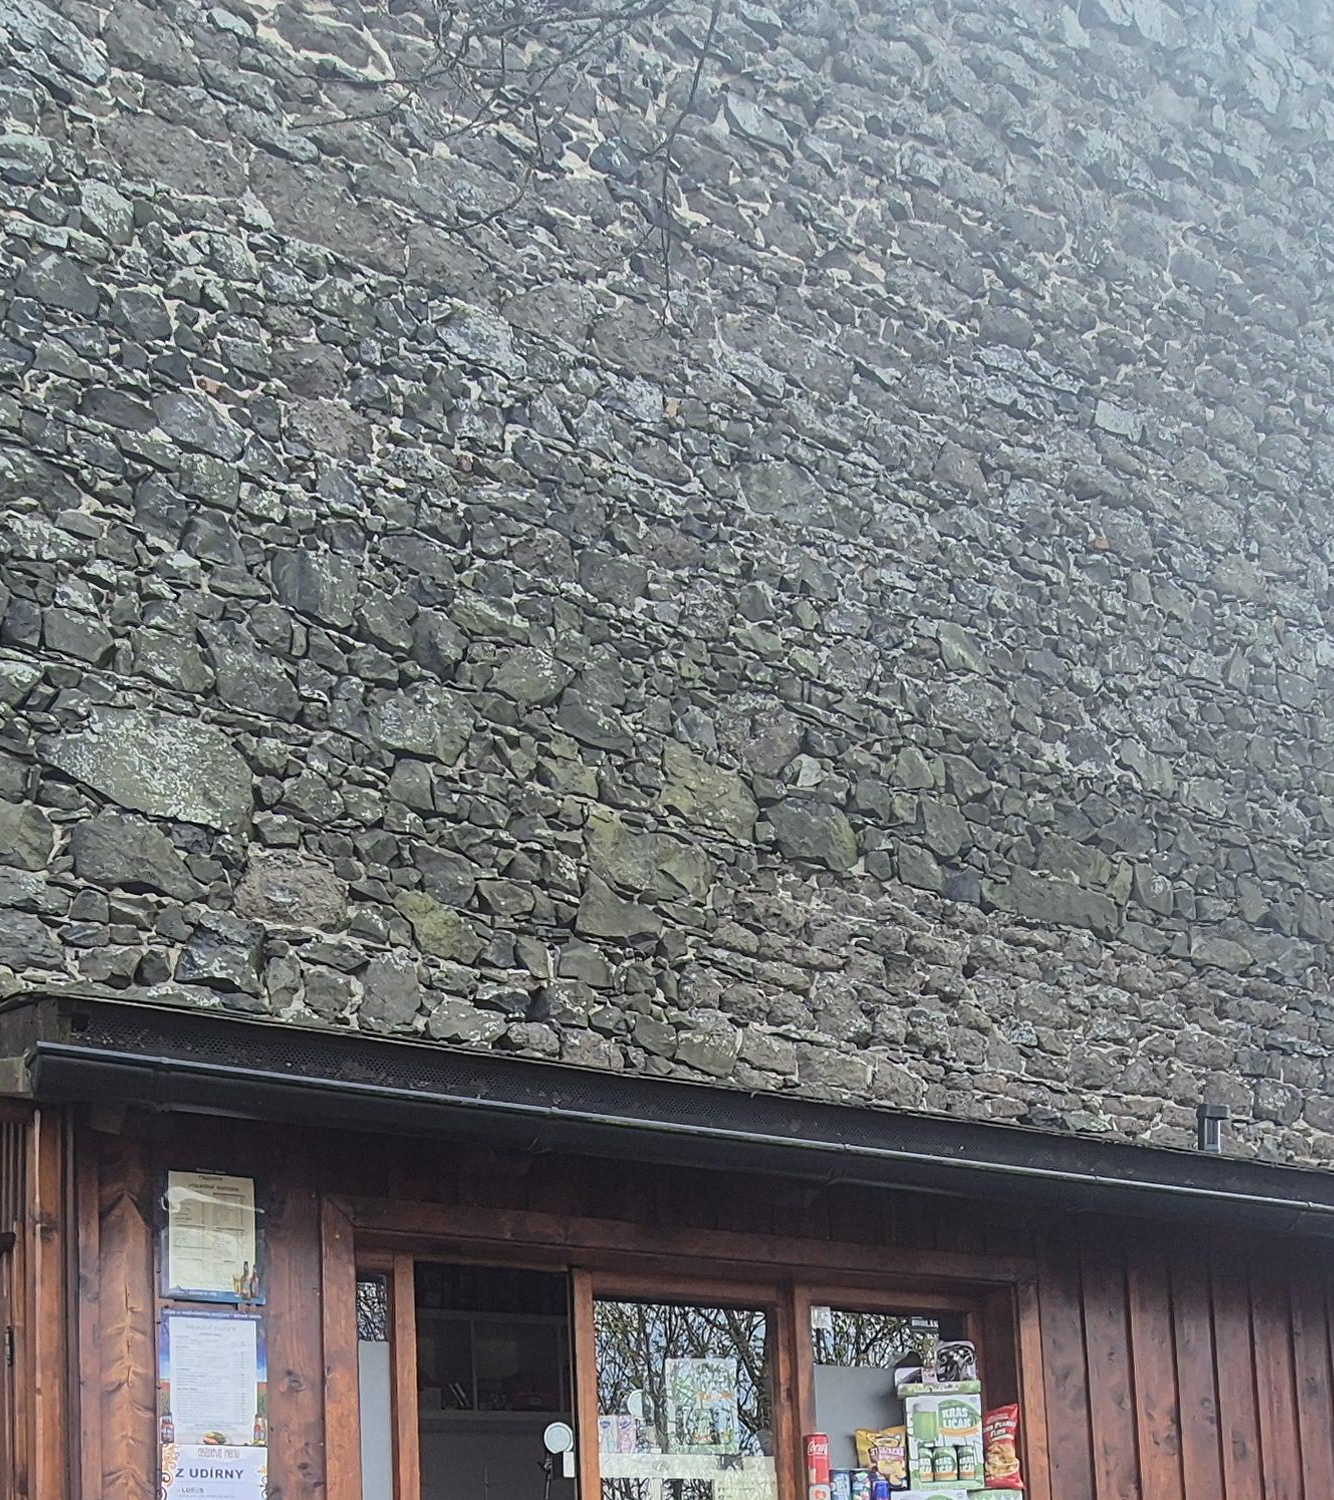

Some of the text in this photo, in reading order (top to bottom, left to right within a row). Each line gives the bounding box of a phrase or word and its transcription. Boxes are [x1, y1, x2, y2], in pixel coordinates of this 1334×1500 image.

[942, 1407, 968, 1418] KRAS
[175, 1466, 244, 1479] Z UDÍRNY
